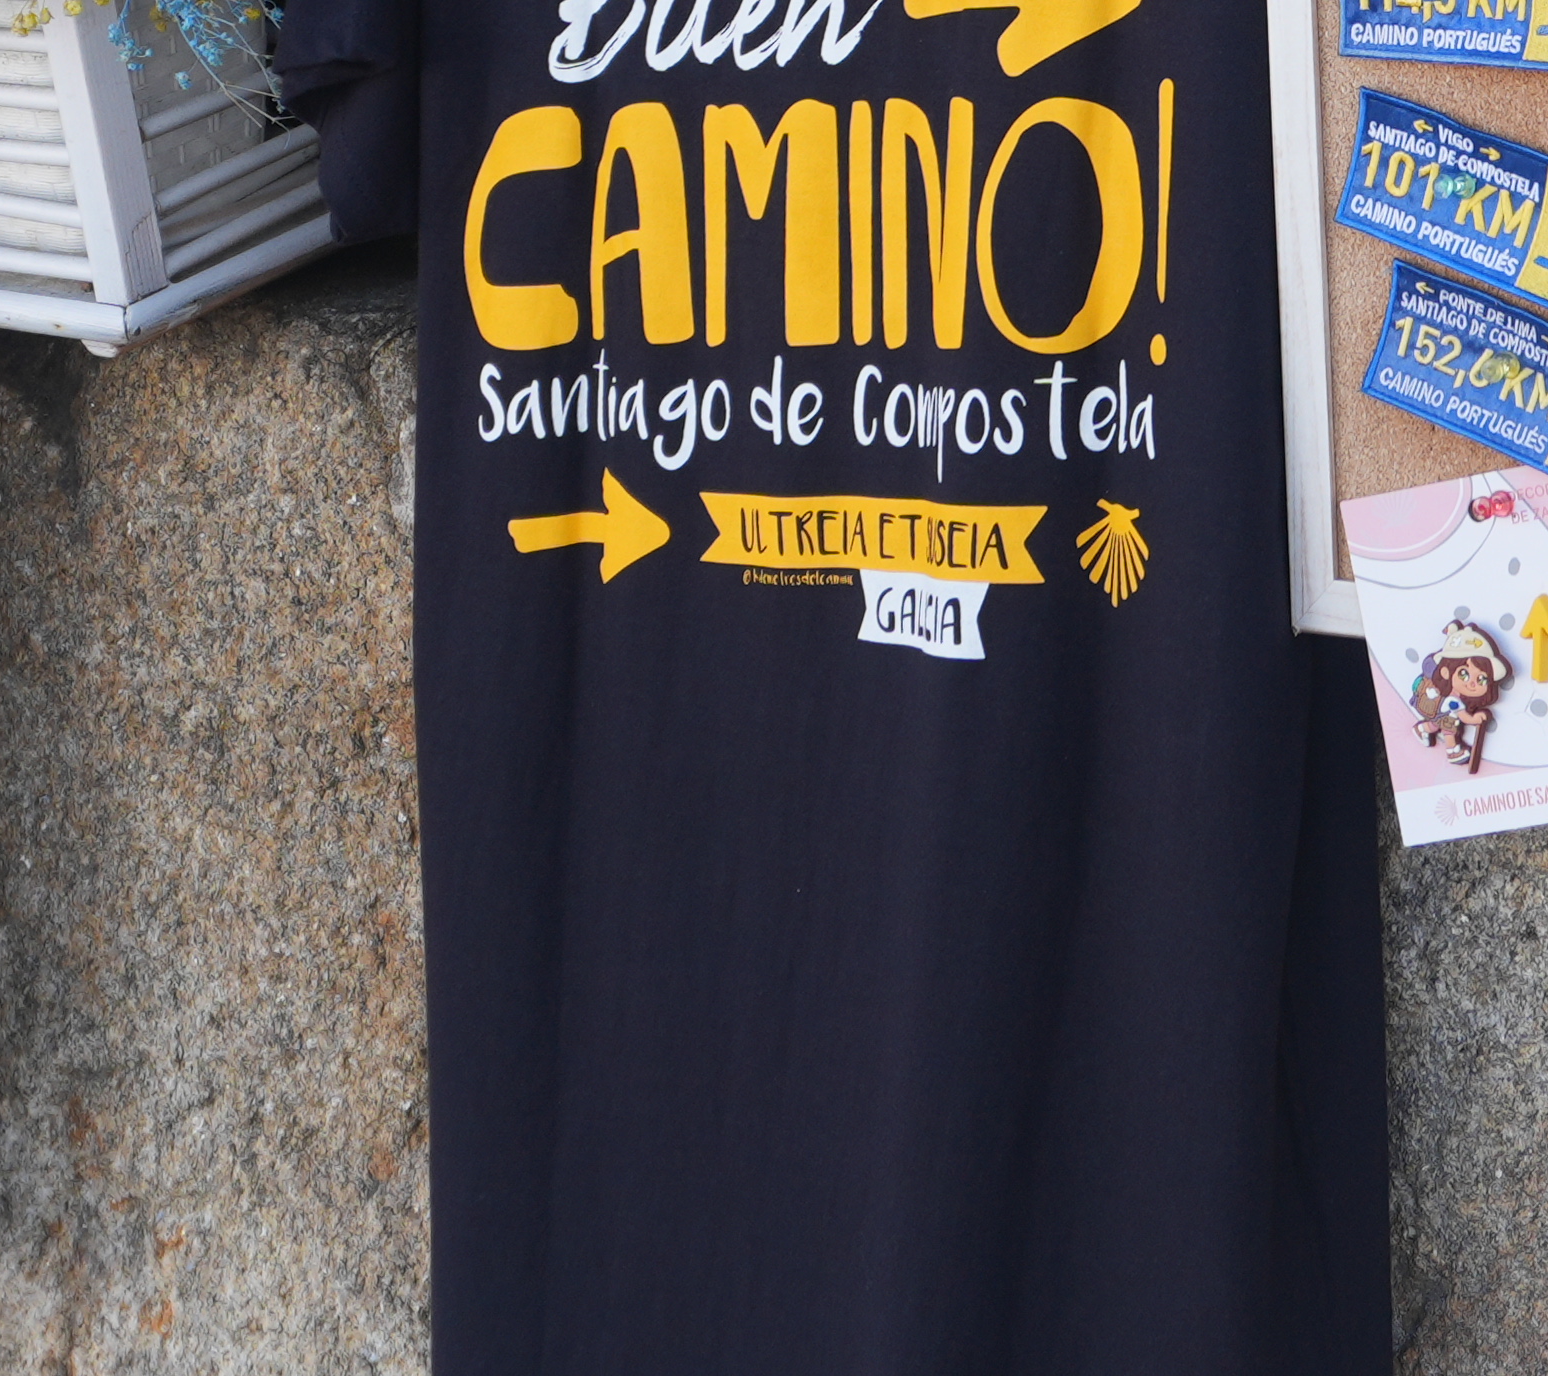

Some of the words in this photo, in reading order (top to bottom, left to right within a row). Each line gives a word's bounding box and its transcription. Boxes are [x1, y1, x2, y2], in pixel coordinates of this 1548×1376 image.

[1351, 22, 1418, 48] CAMINO
[1422, 25, 1522, 54] PORTUGUÉS
[1438, 124, 1474, 153] VIGO
[464, 78, 1174, 365] CAMINO!
[1439, 289, 1486, 320] PONTE
[1486, 306, 1507, 326] DE
[1507, 313, 1537, 343] LIMA
[478, 349, 732, 471] Santiago
[749, 355, 824, 446] de
[852, 360, 1156, 483] Compostela
[740, 507, 868, 557] ULTREIA
[878, 513, 922, 561] ET
[925, 516, 1009, 570] SUSEIA
[1462, 793, 1516, 818] CAMINO
[1516, 789, 1535, 809] DE
